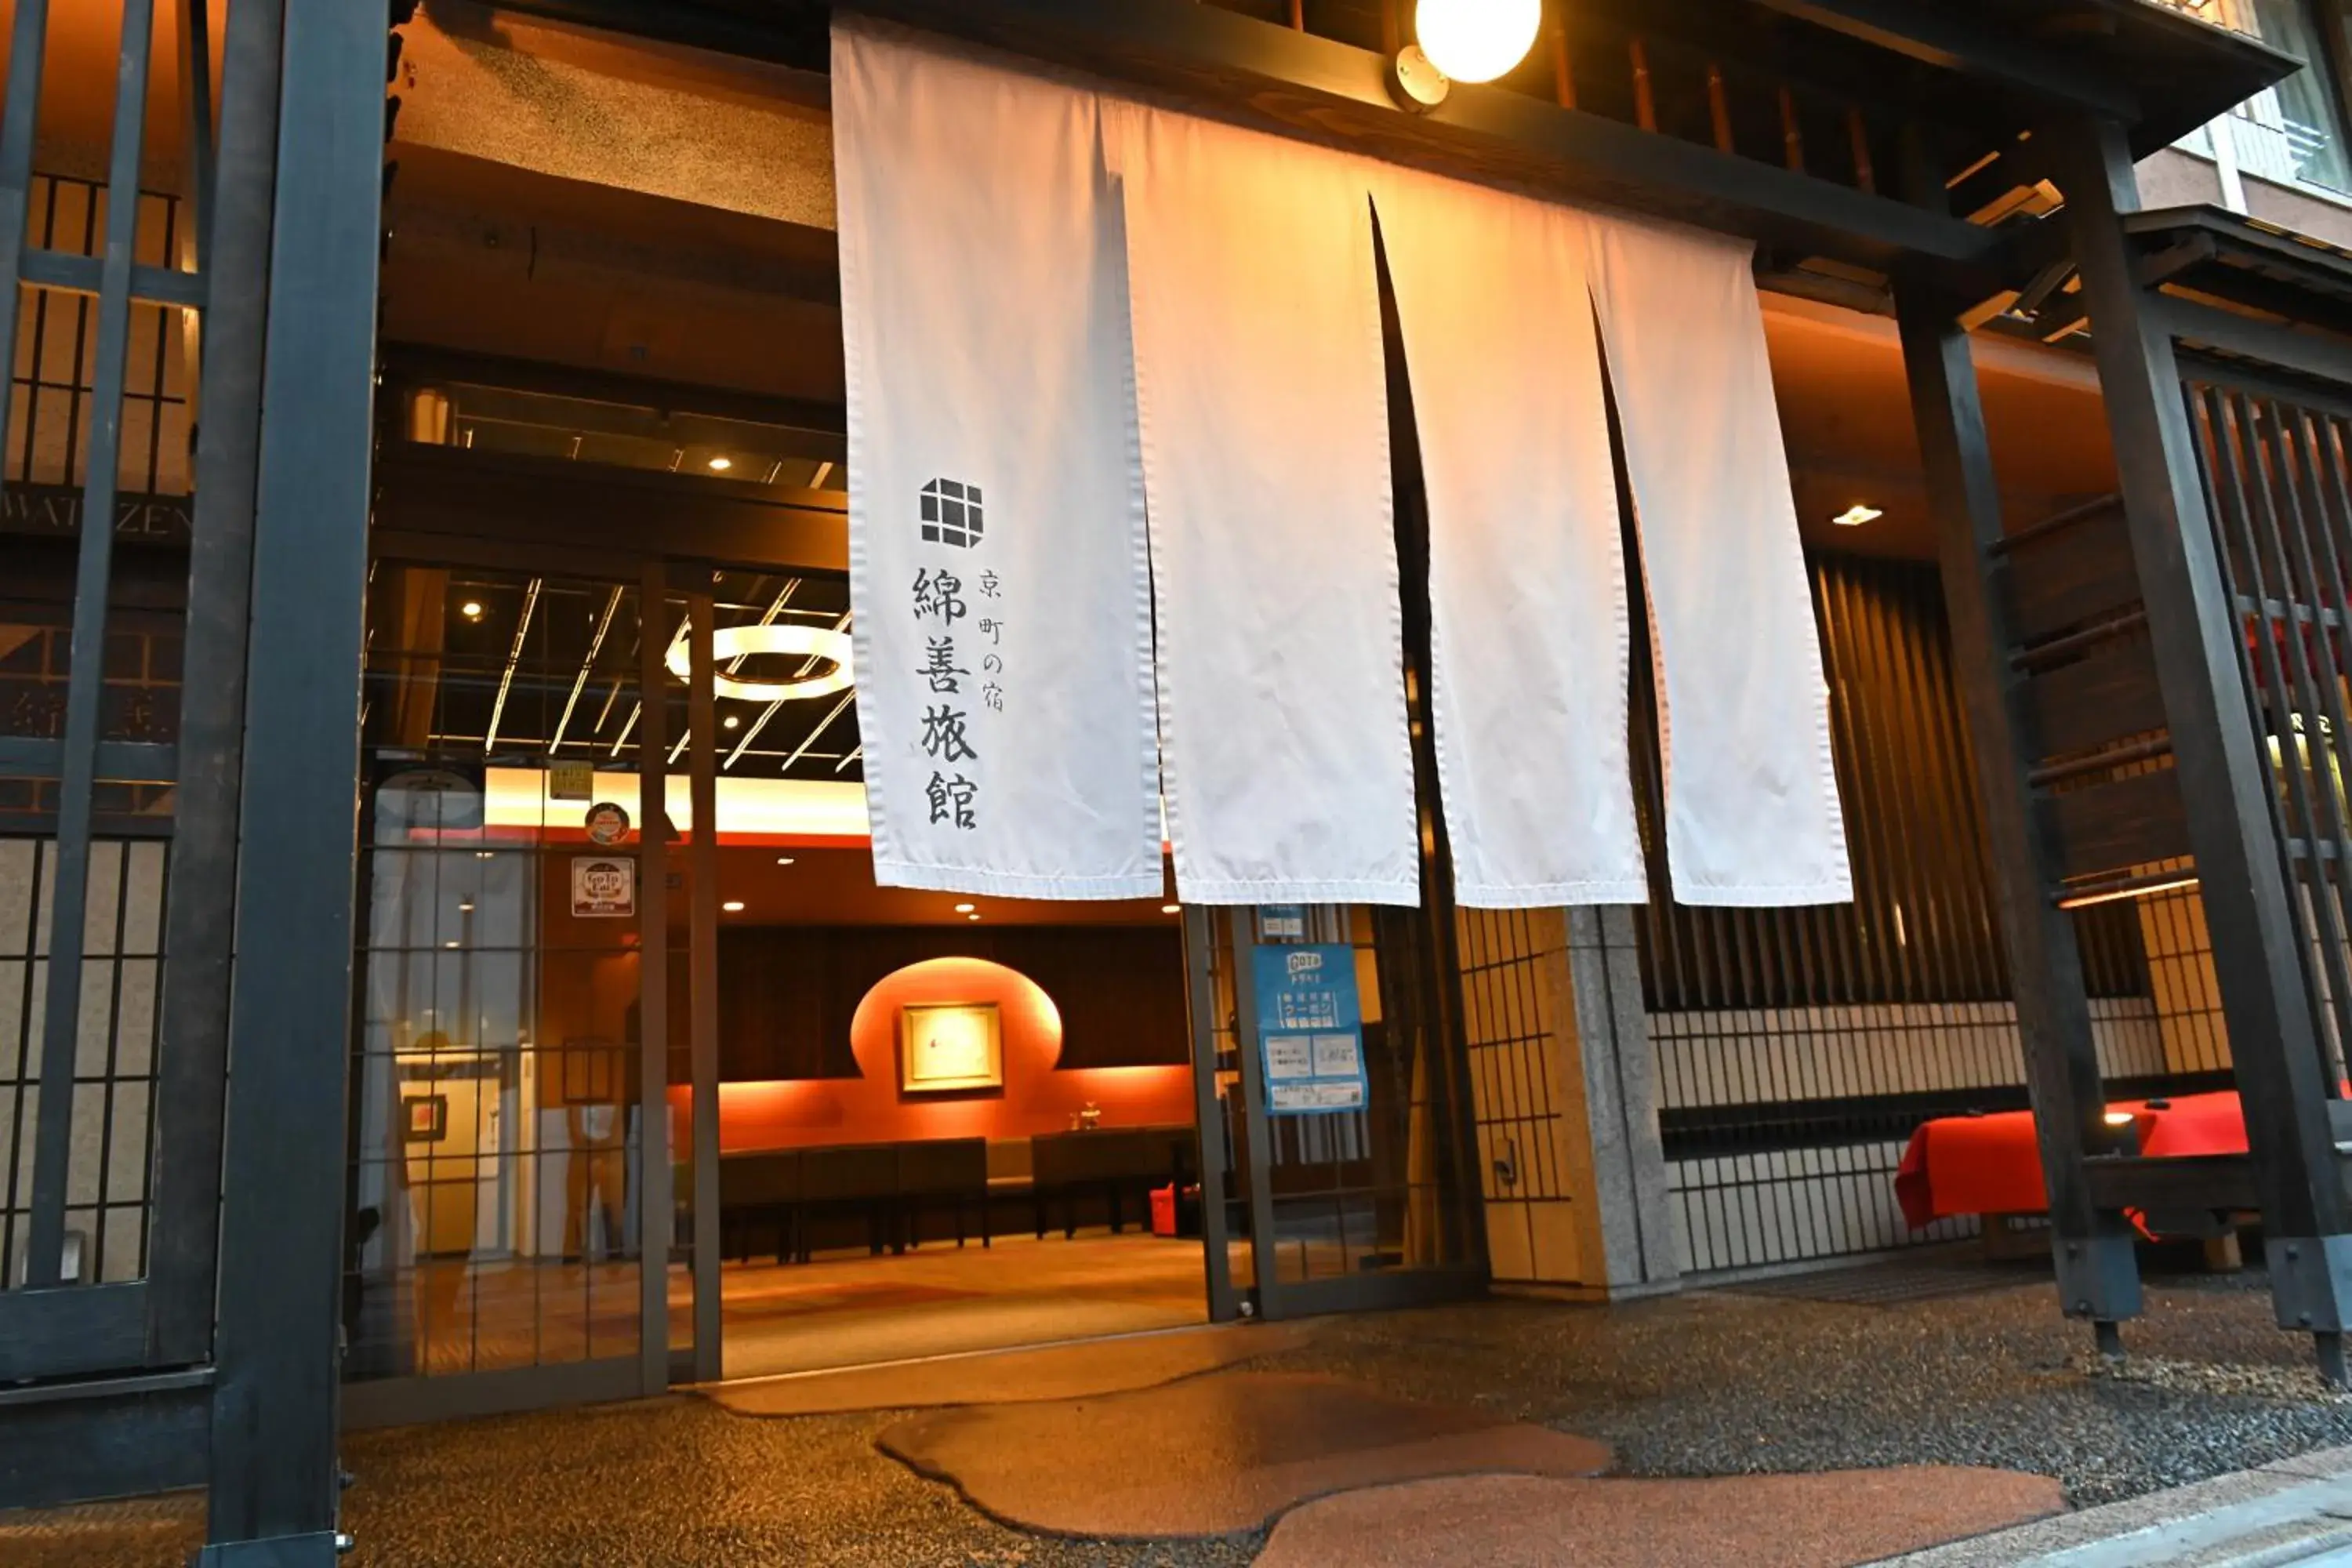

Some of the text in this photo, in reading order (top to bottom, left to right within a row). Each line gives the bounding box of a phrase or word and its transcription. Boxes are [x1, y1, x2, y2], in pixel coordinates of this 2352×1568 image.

[912, 567, 978, 830] 綿善旅館
[978, 569, 1004, 713] 京町の宿
